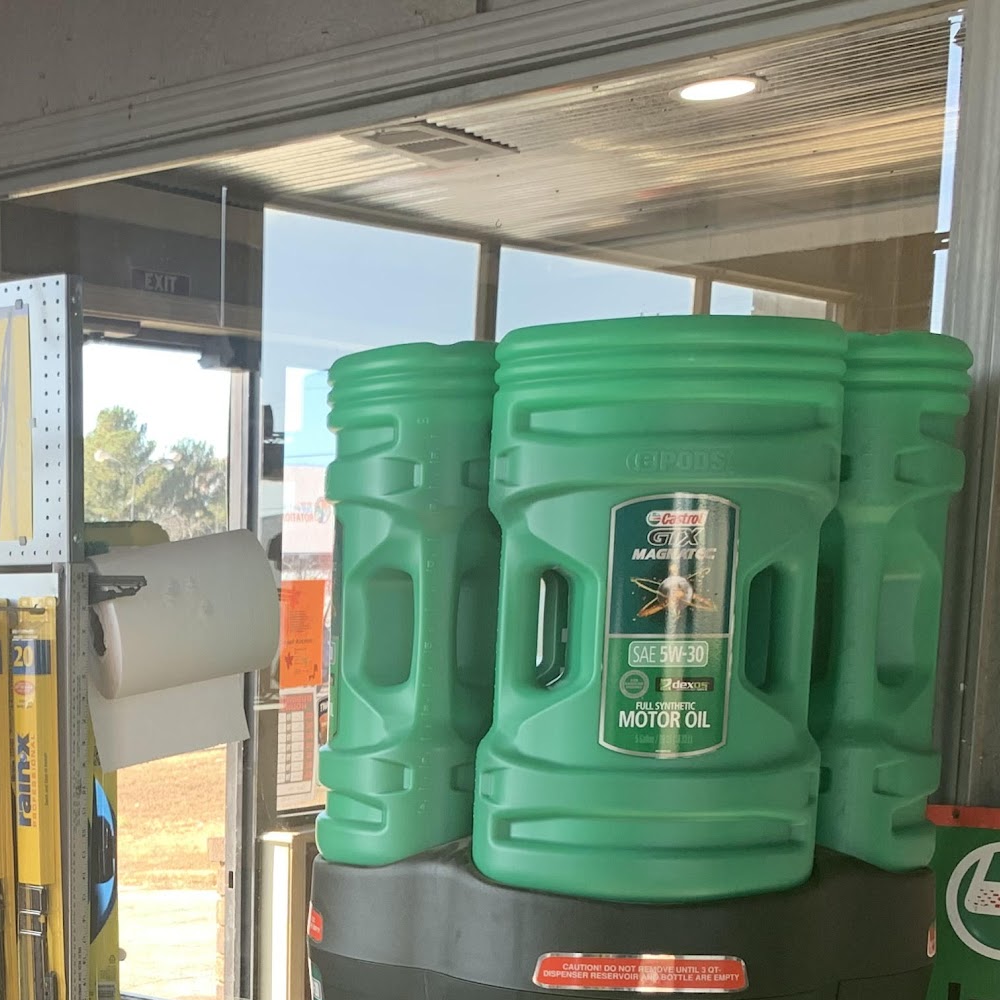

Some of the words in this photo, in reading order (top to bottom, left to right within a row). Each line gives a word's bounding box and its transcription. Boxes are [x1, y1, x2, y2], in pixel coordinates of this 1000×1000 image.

[144, 272, 178, 293] EXIT
[660, 512, 706, 526] Castrol
[647, 527, 706, 547] GTX
[13, 646, 33, 668] 20
[633, 646, 656, 664] SAE
[660, 645, 704, 664] 5W-30
[672, 680, 710, 692] dexos
[636, 702, 654, 710] FULL
[655, 702, 696, 710] SYNTHETIC
[618, 710, 681, 728] MOTOR
[684, 710, 711, 728] OIL
[543, 970, 589, 978] DISPENSER
[590, 972, 639, 980] RESERVOIR
[562, 962, 602, 971] CAUTION!
[604, 964, 616, 972] DO
[638, 966, 674, 974] REMOVE
[676, 966, 700, 974] UNTIL
[702, 966, 706, 974] 3
